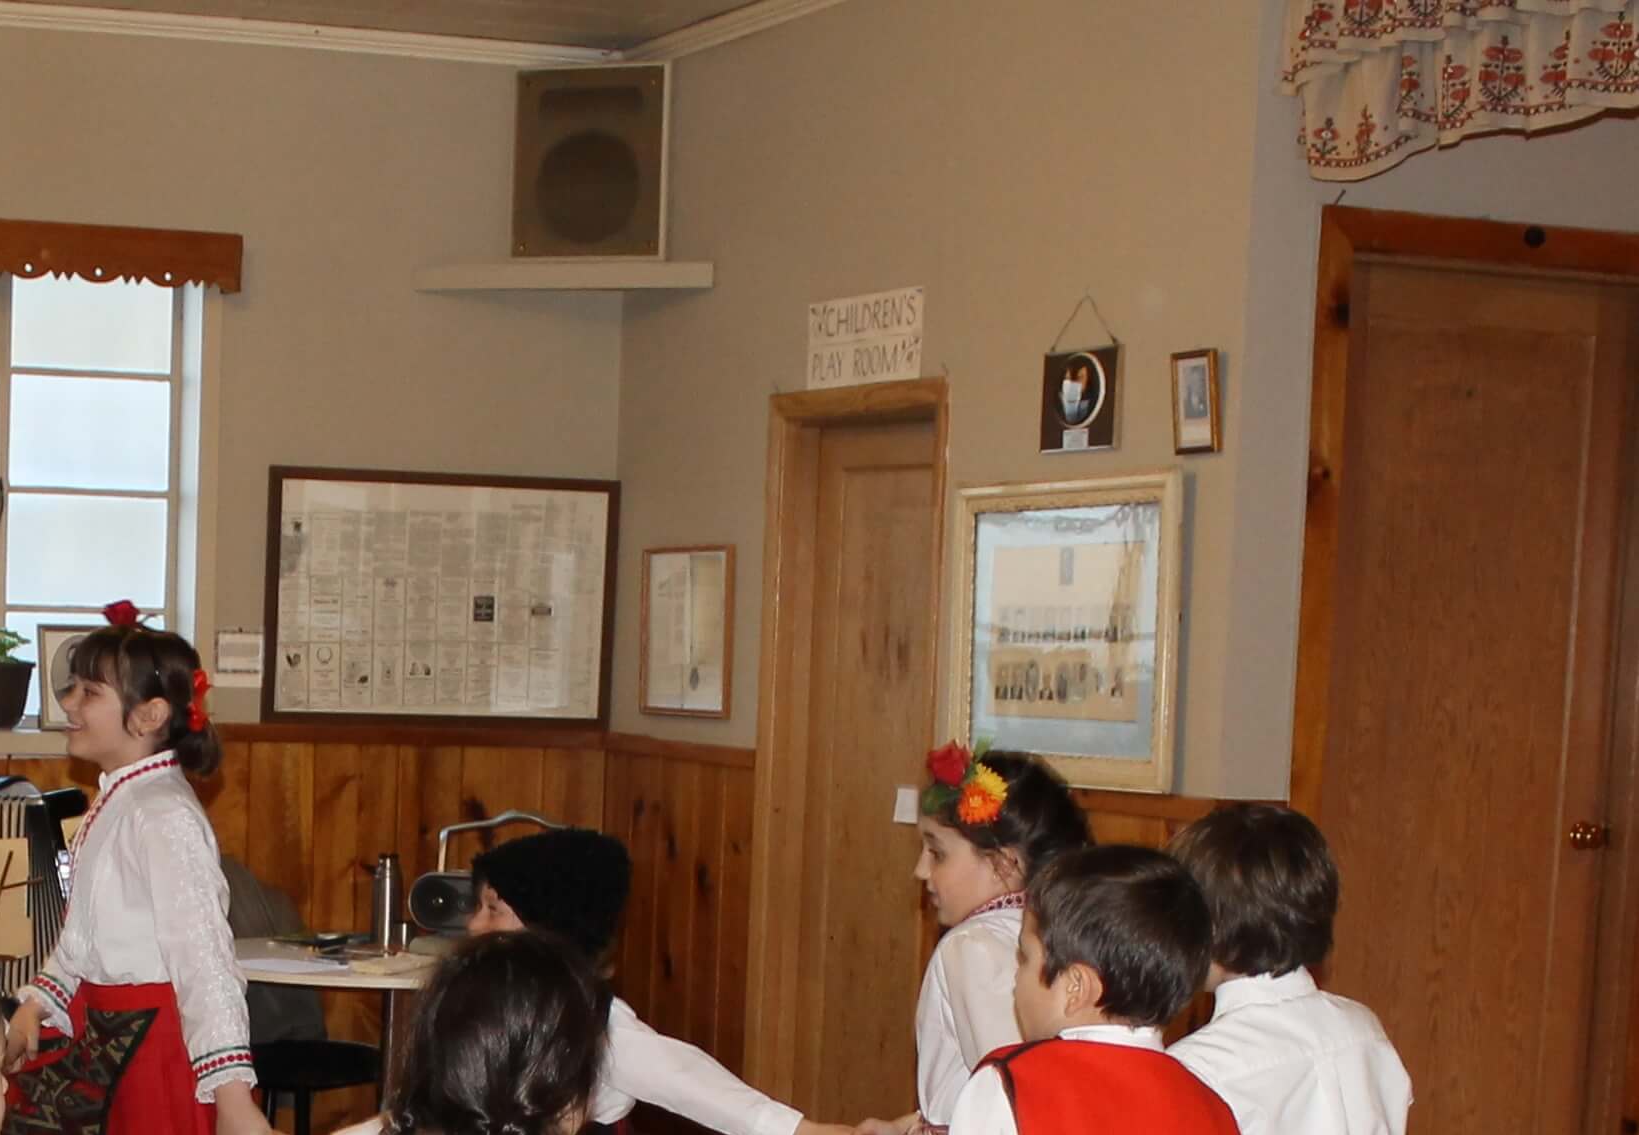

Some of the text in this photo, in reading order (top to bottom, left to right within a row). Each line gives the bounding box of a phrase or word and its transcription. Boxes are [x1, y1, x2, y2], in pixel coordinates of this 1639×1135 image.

[826, 293, 917, 337] CHILDREN'S
[811, 343, 898, 382] PLAY ROOM
